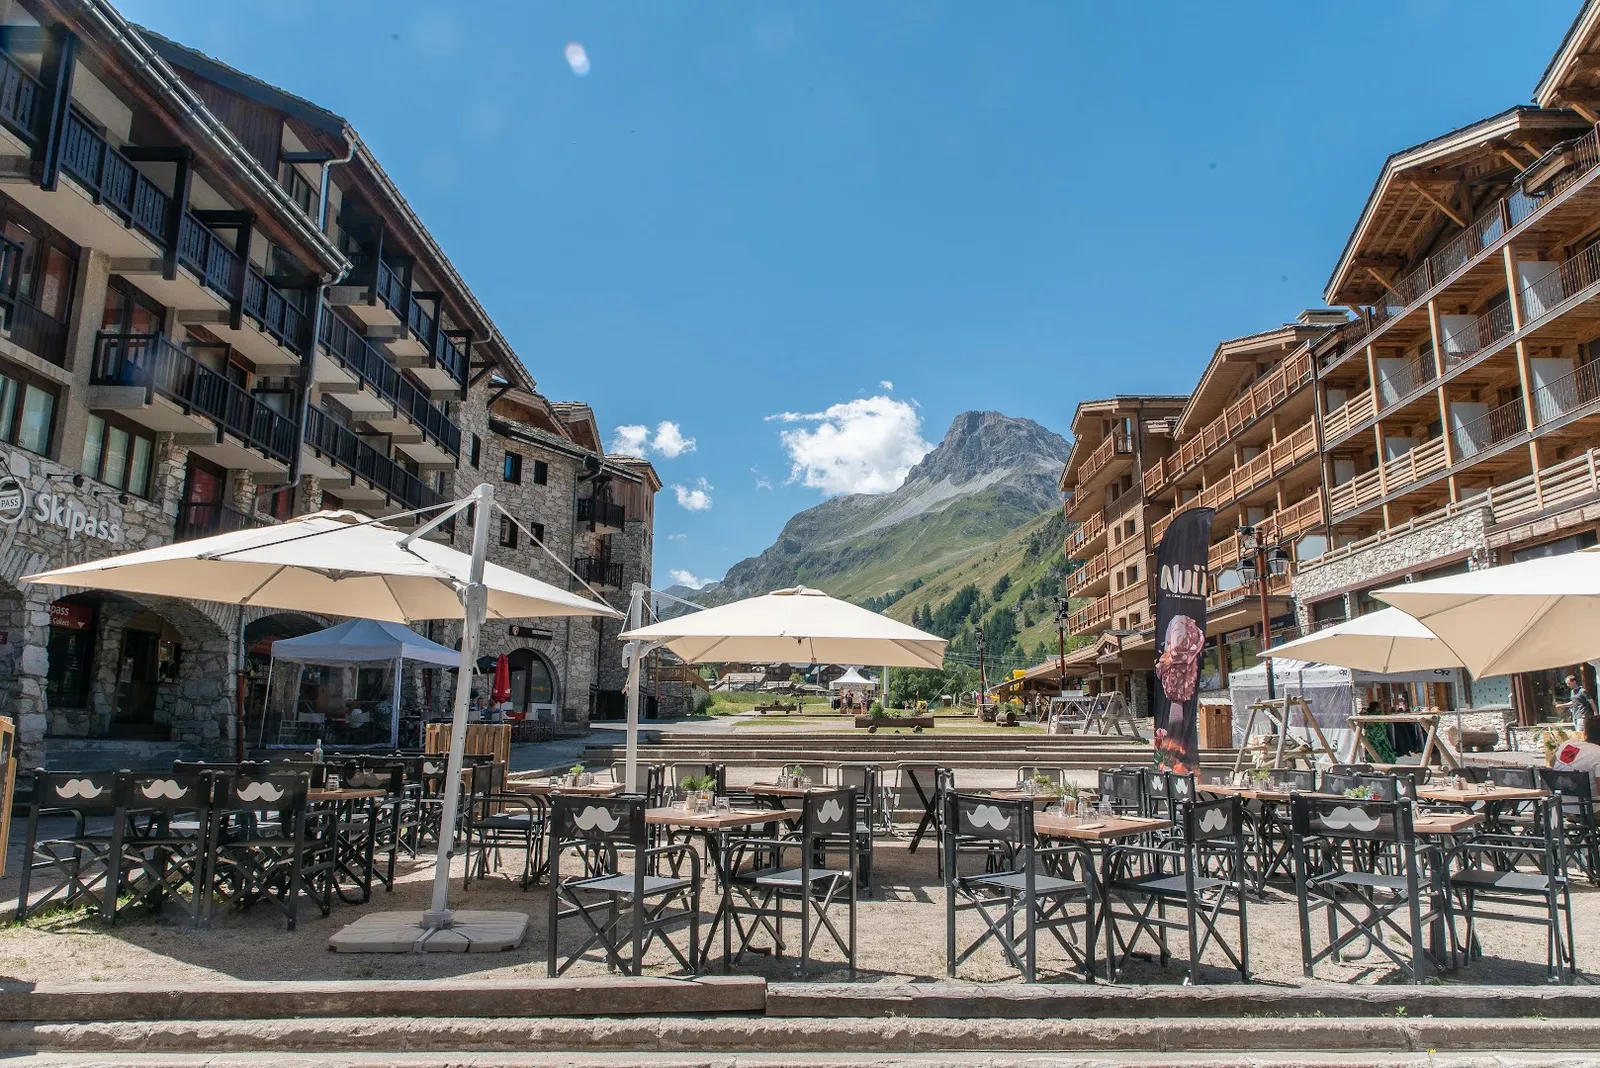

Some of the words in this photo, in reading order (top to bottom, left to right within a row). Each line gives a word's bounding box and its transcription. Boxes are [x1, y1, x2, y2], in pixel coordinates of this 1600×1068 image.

[1, 498, 19, 508] PASS
[34, 493, 120, 543] Skipass
[52, 618, 70, 627] Collect
